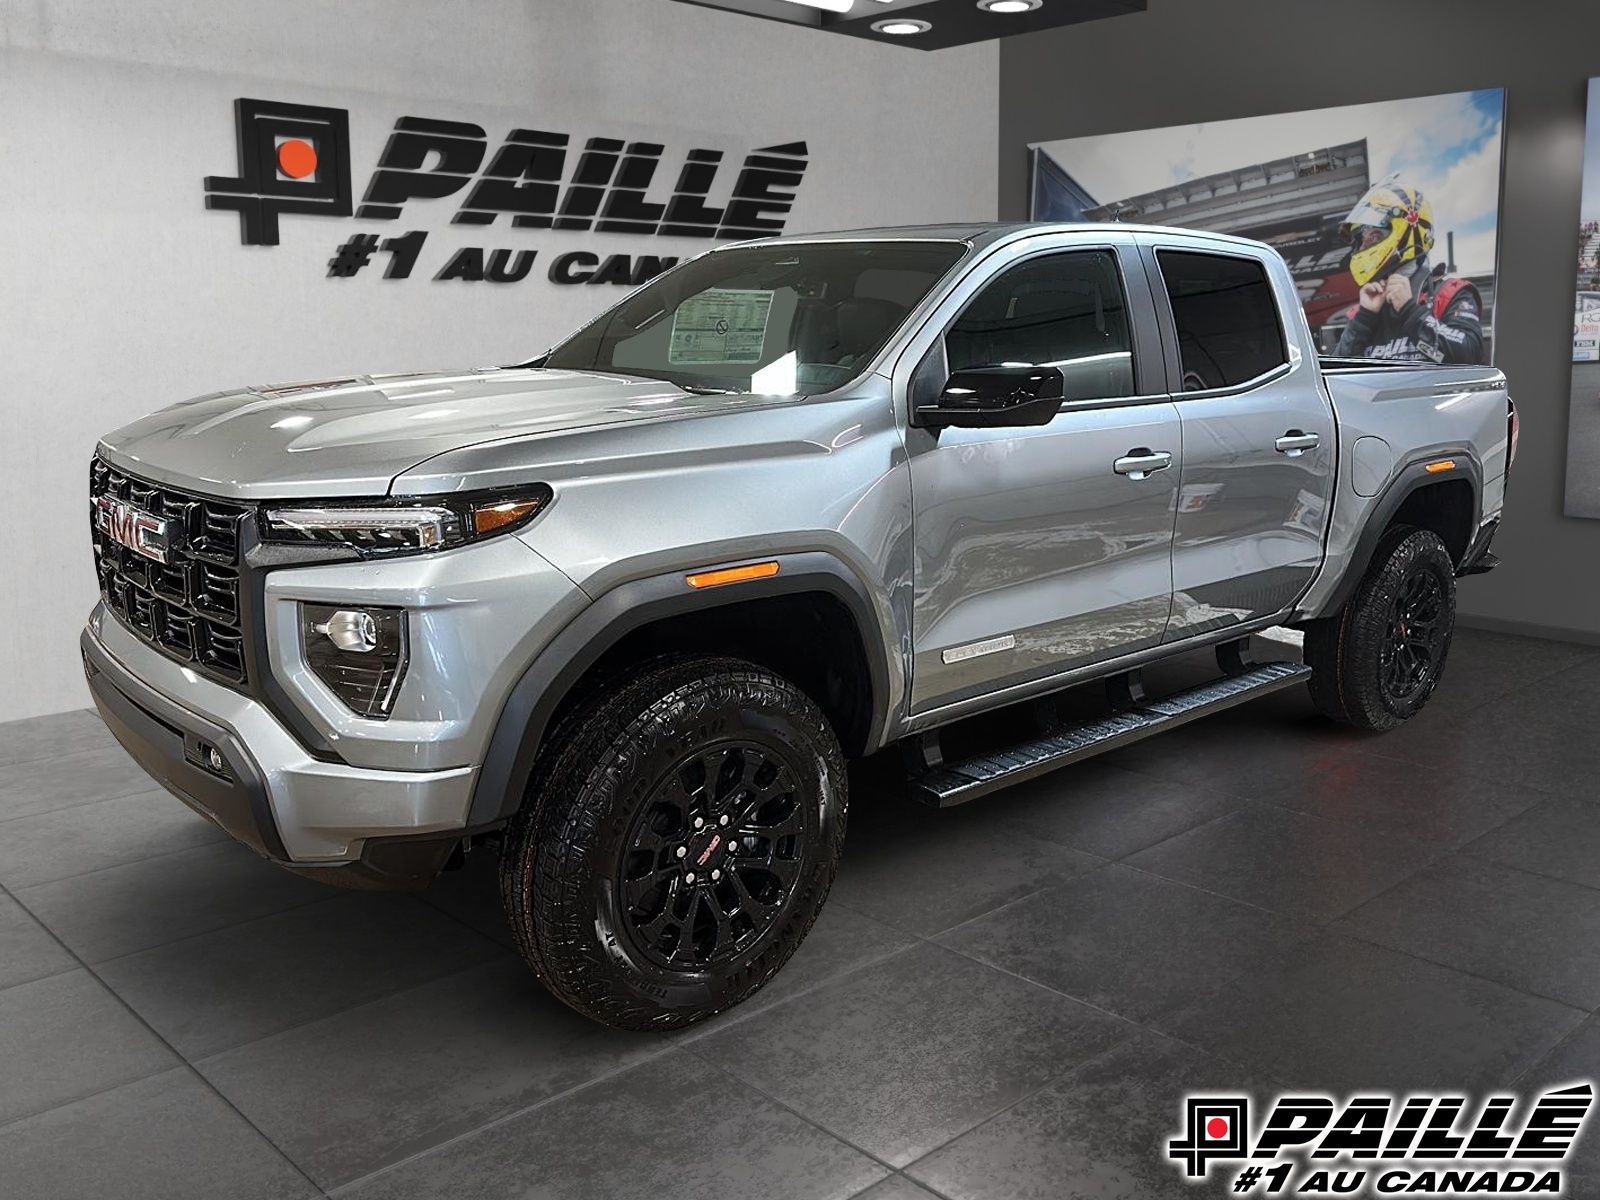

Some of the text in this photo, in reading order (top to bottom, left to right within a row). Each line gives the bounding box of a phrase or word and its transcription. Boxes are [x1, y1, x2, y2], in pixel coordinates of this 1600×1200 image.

[355, 115, 808, 240] PAILLÉ
[326, 231, 680, 286] #1 AU CAN
[96, 497, 167, 564] GMC
